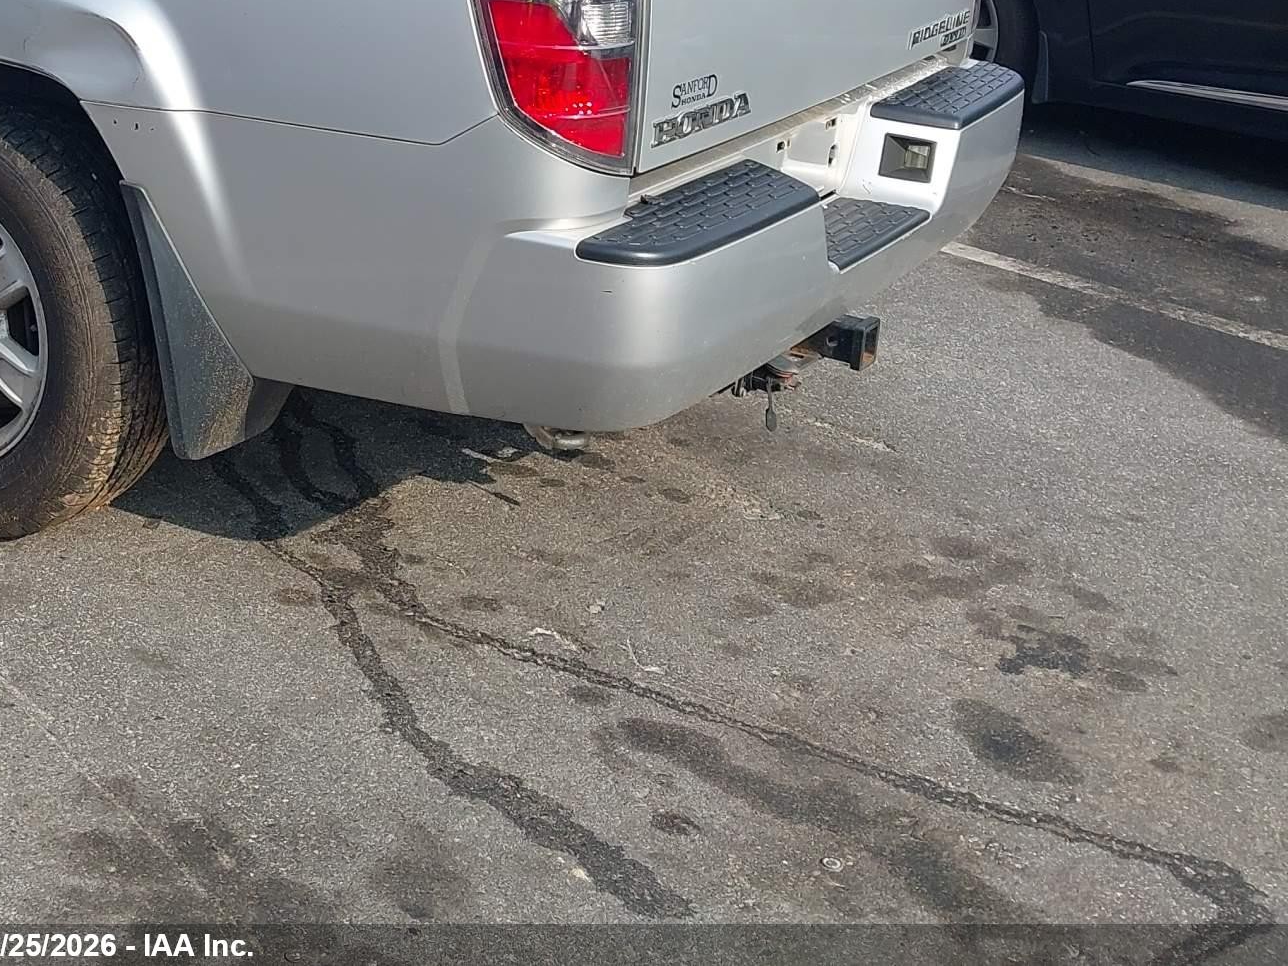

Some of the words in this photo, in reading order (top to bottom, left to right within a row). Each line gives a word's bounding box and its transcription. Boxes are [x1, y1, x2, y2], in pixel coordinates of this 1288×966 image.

[908, 10, 971, 50] RIDGELINE
[671, 74, 718, 108] SANFORD
[681, 92, 706, 106] HONDA
[651, 92, 752, 149] HONDA
